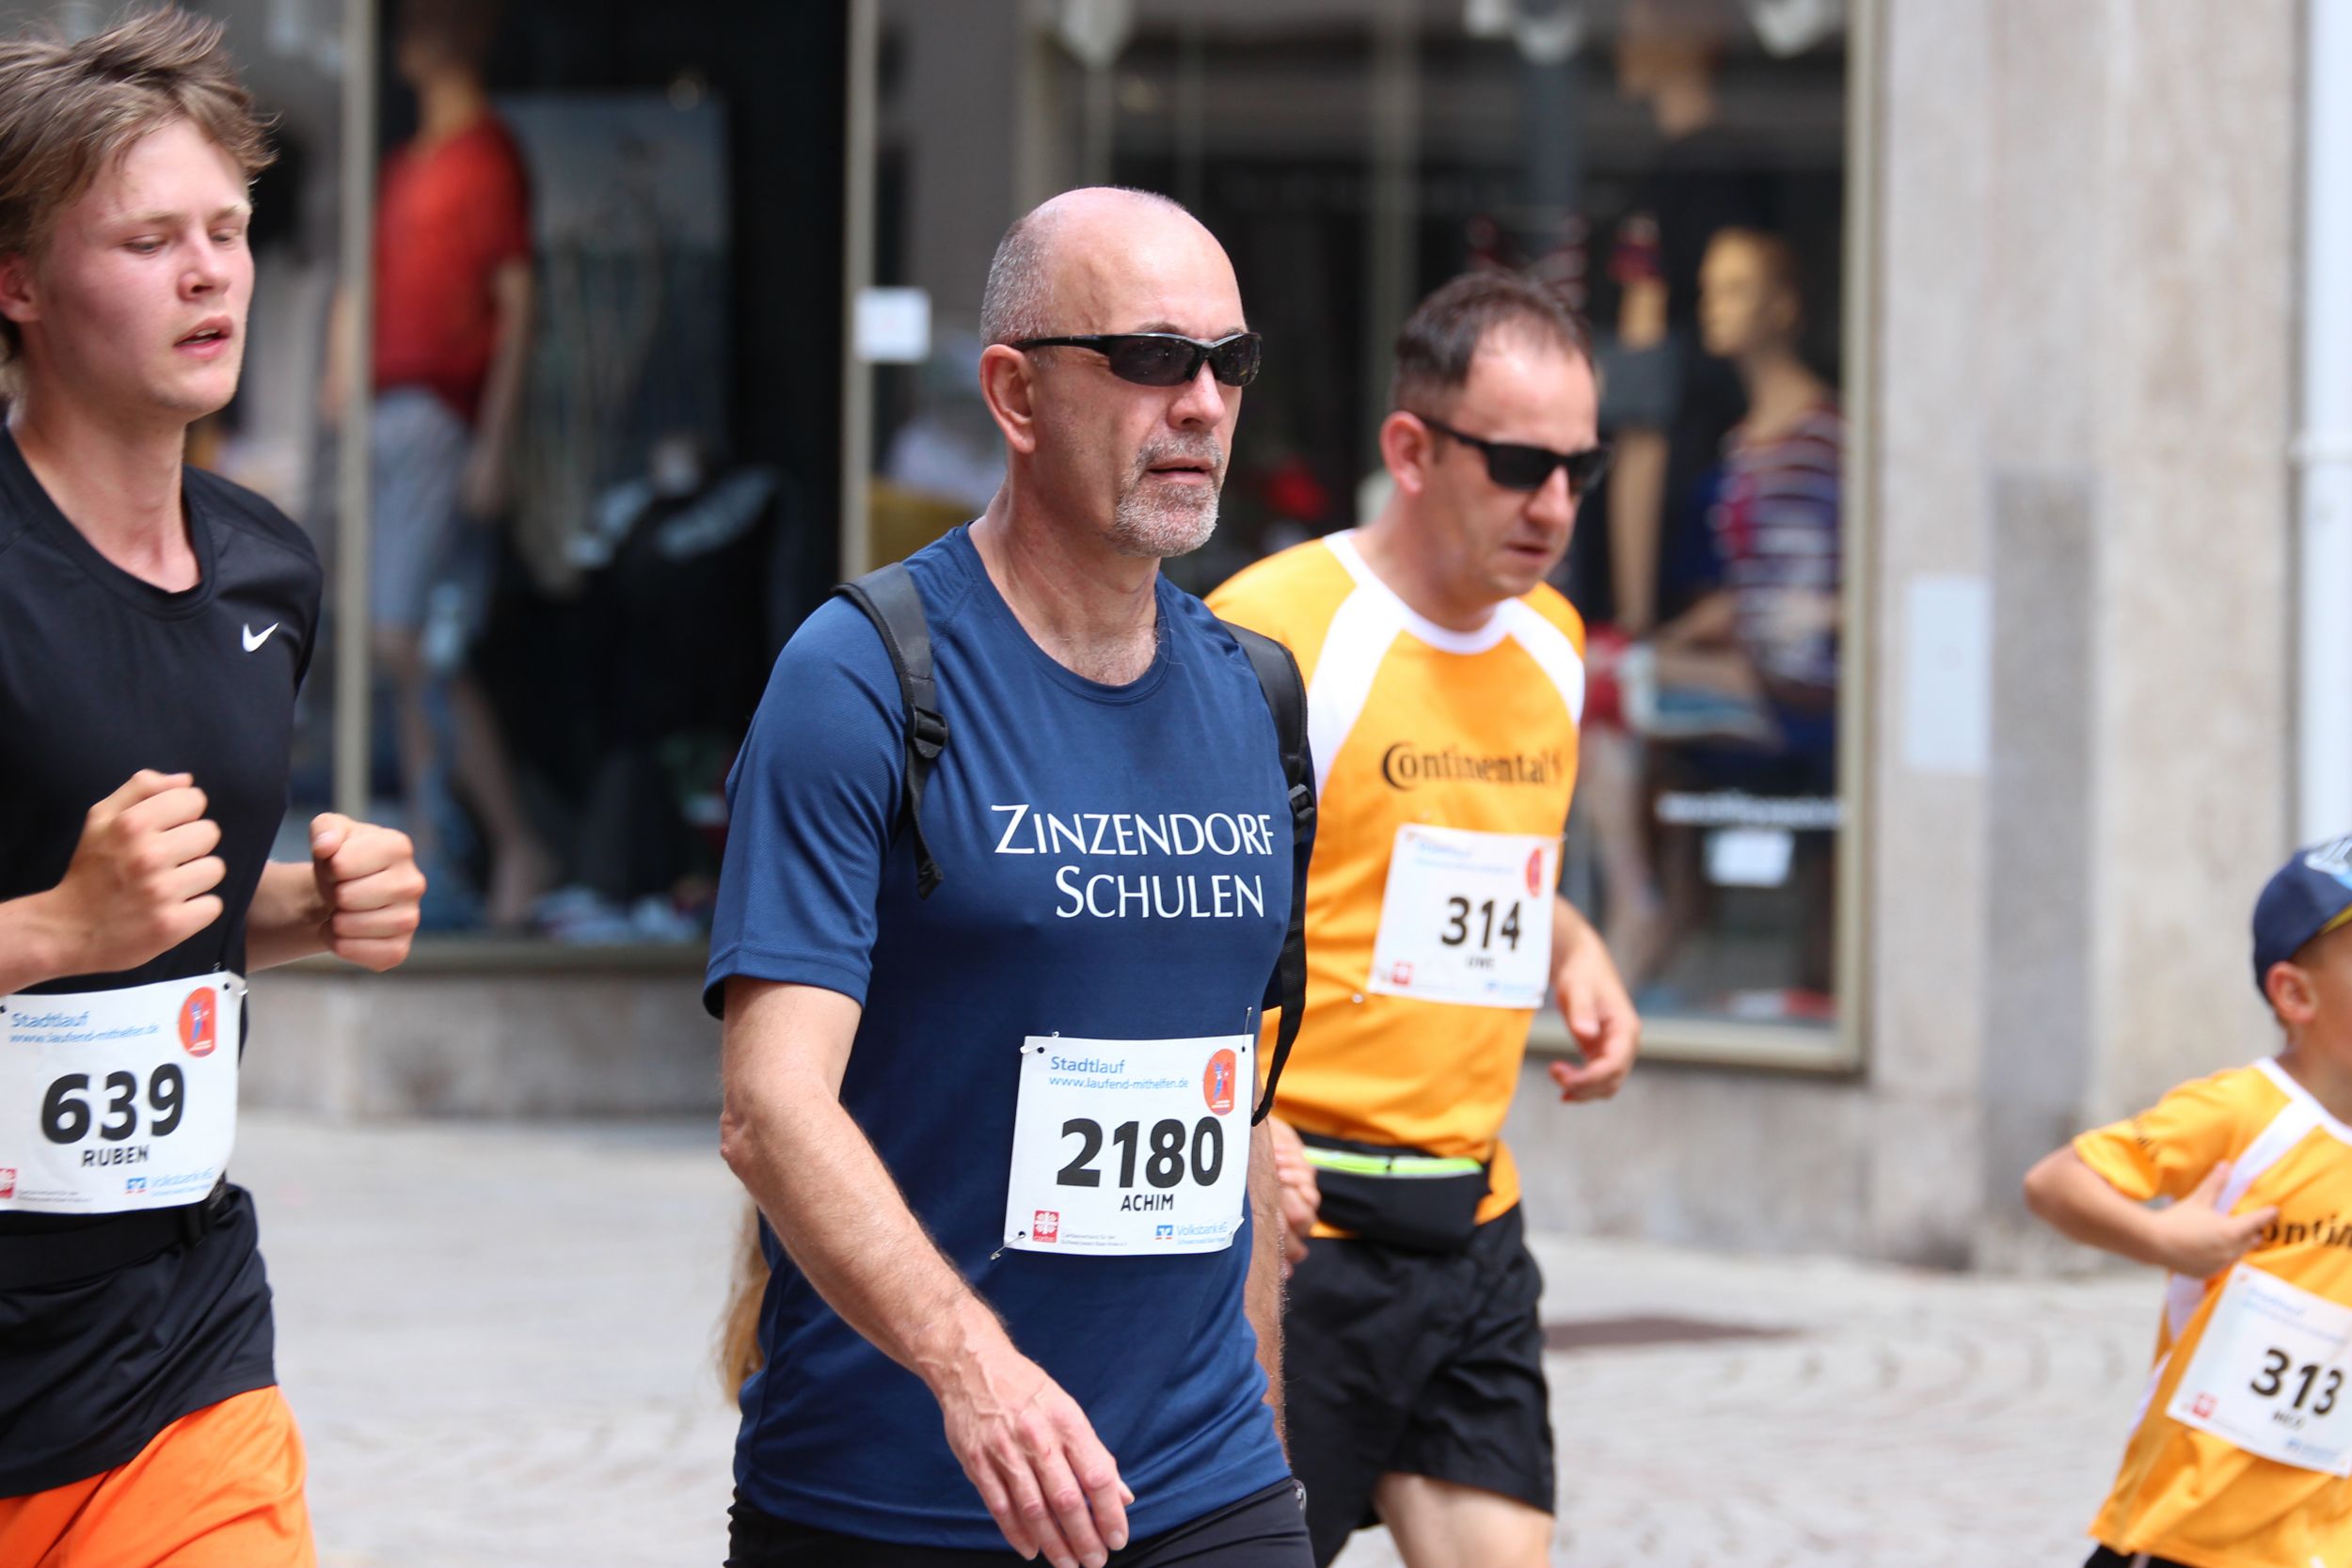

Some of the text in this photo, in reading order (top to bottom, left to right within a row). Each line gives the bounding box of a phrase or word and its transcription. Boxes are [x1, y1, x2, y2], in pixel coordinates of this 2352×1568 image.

[1381, 741, 1553, 790] Continental
[991, 804, 1274, 855] ZINZENDORF
[1055, 865, 1264, 918] SCHULEN
[1440, 895, 1521, 951] 314
[10, 1010, 90, 1028] Stadtlauf
[1049, 1076, 1189, 1090] www.laufend-mithelfen.de
[1051, 1055, 1125, 1074] Stadtlauf
[41, 1063, 184, 1145] 639
[81, 1145, 150, 1167] RUBEN
[1056, 1117, 1223, 1189] 2180
[1120, 1194, 1174, 1212] ACHIM
[2256, 1213, 2352, 1247] ontin
[2249, 1347, 2343, 1416] 313
